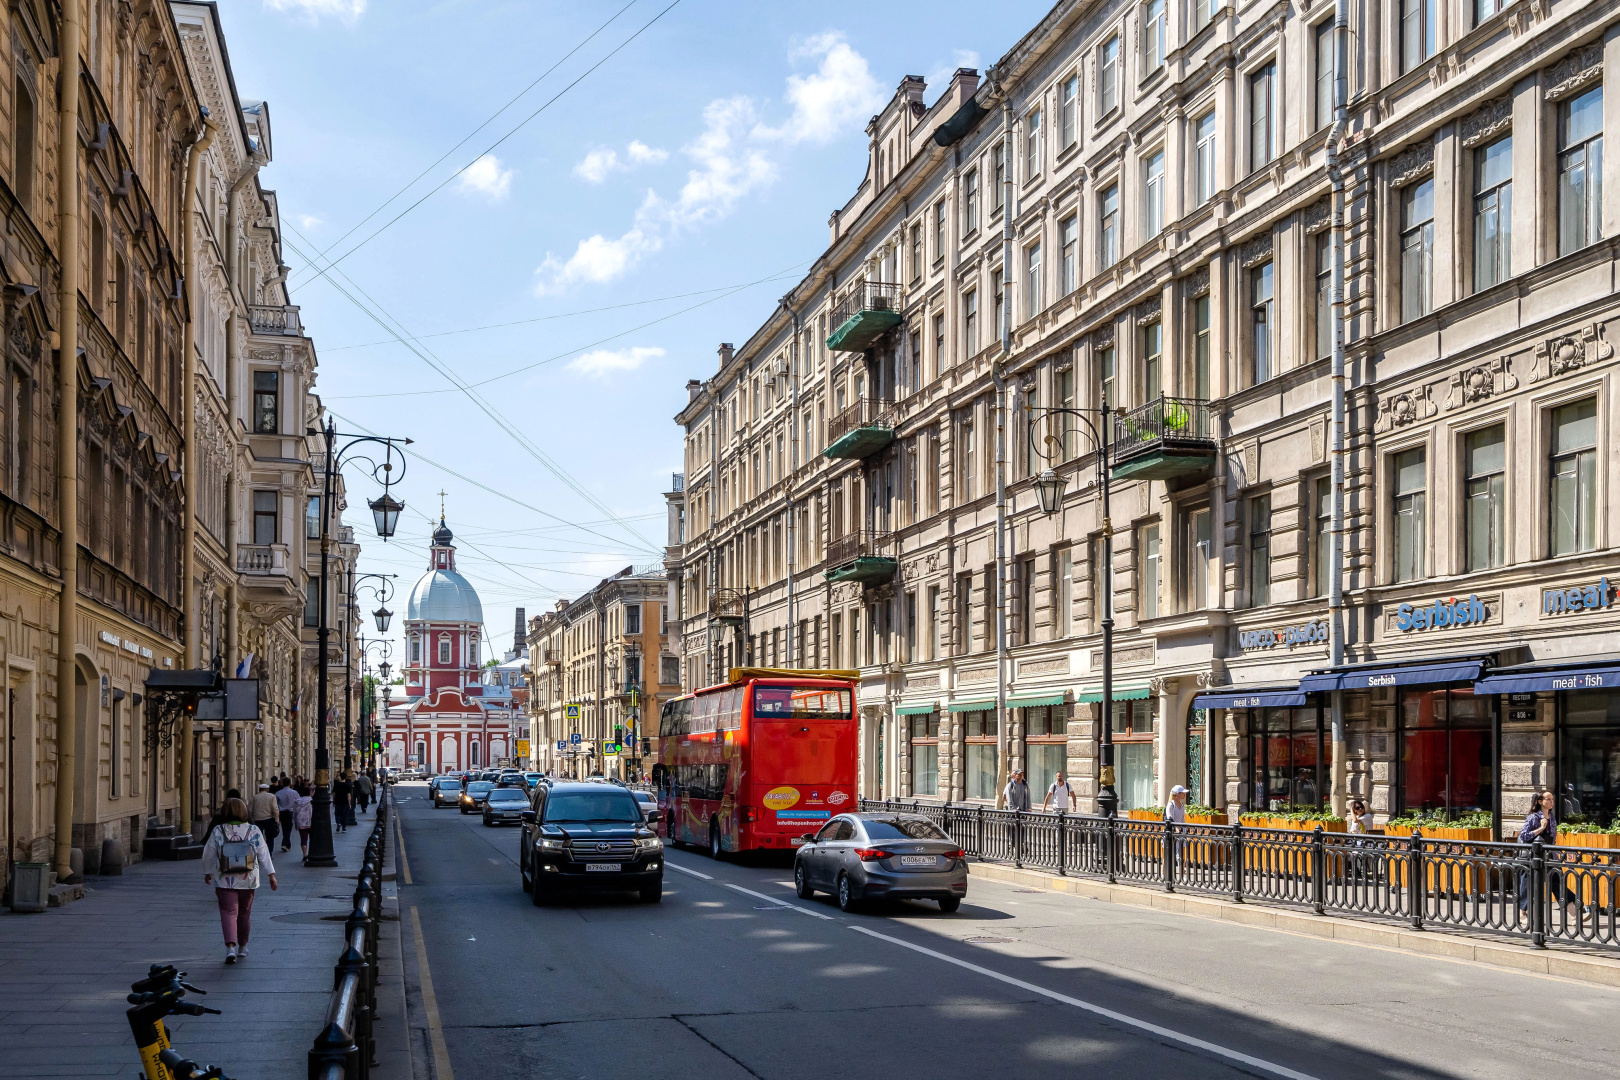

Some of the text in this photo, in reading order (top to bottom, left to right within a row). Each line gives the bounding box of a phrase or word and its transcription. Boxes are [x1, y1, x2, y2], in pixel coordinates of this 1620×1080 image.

[1544, 576, 1610, 613] meat
[1397, 594, 1486, 631] Serbish
[1239, 618, 1329, 649] мясо рыба
[1368, 674, 1396, 686] Serbish
[1552, 674, 1603, 689] meat fish
[1233, 697, 1261, 707] meat fish
